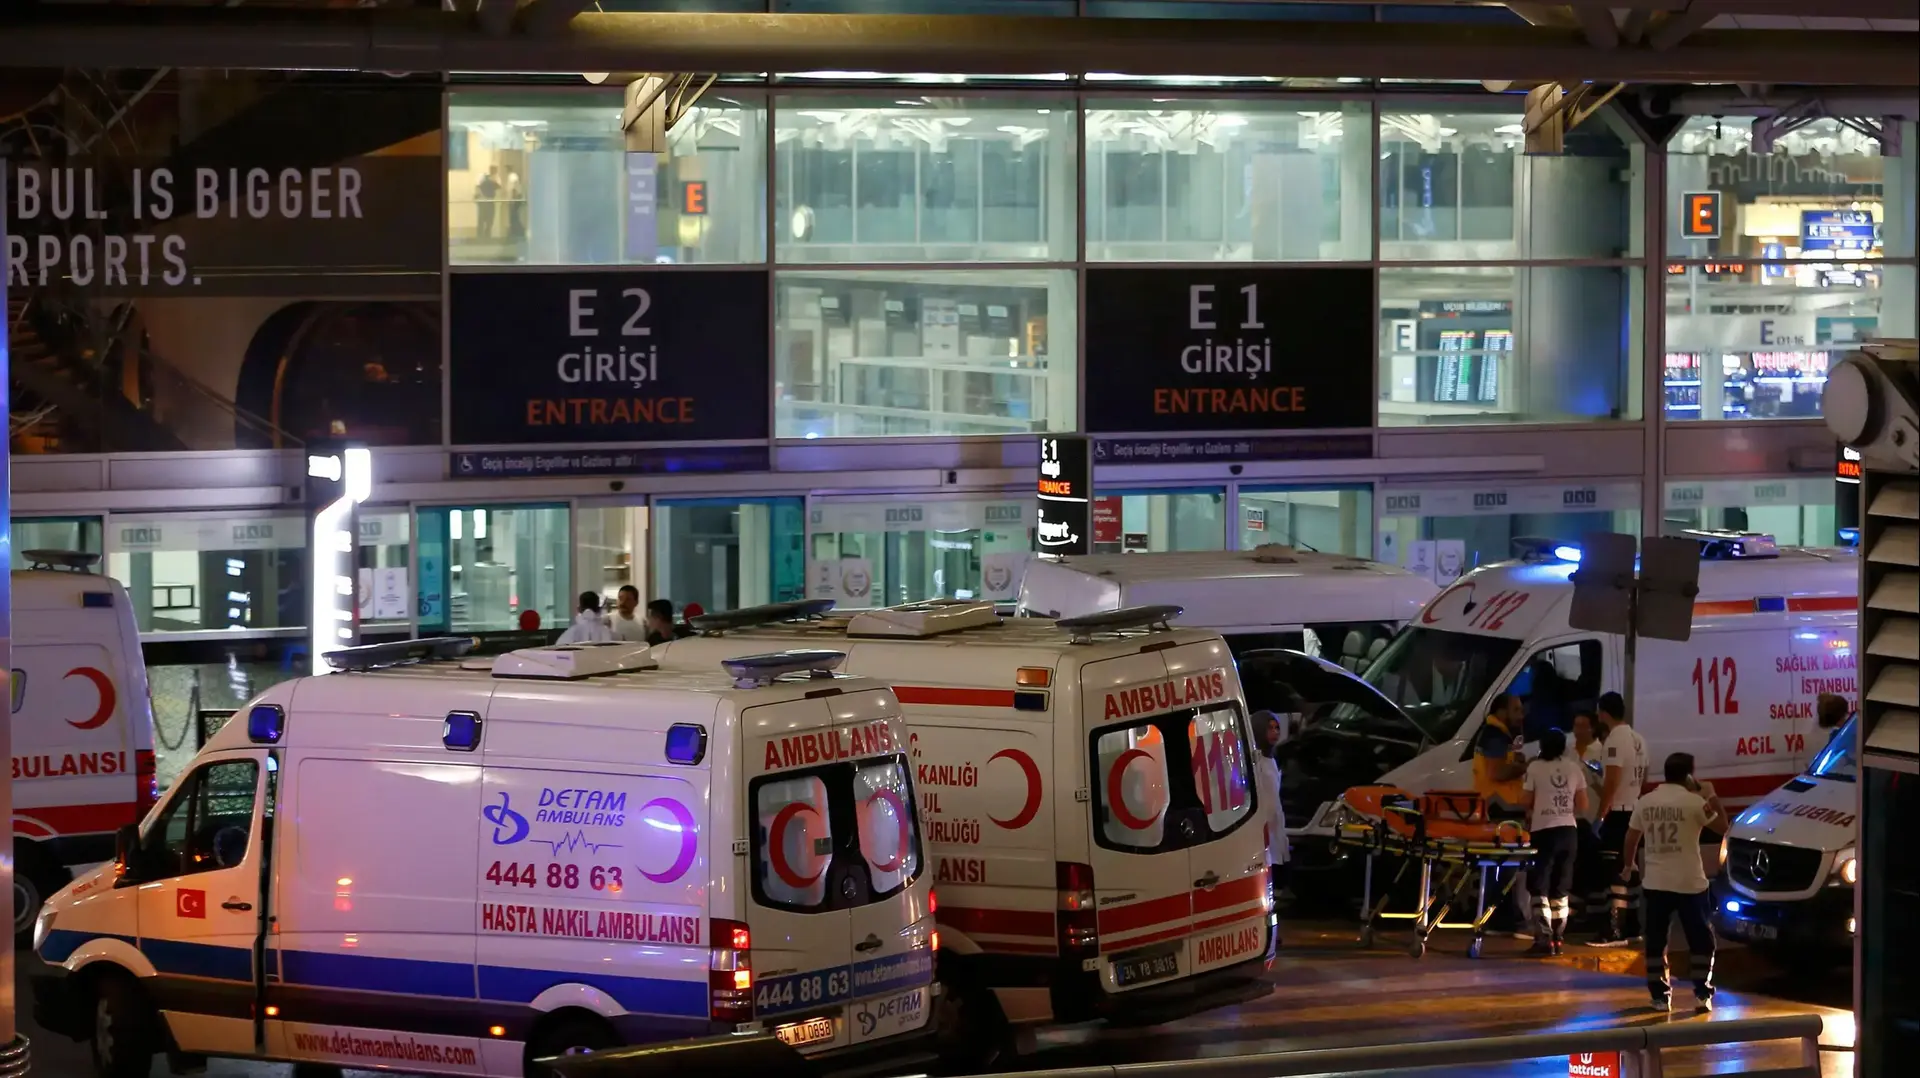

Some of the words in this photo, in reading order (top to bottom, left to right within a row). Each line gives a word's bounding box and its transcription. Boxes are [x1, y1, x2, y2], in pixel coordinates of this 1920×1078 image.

[18, 168, 107, 219] BUL
[134, 168, 174, 218] IS
[197, 167, 363, 218] BIGGER
[686, 184, 704, 212] E
[1691, 196, 1713, 233] E
[7, 235, 202, 286] RPORTS.
[569, 289, 598, 336] E
[621, 288, 650, 336] 2
[1190, 285, 1216, 329] E
[1240, 284, 1264, 328] 1
[1397, 324, 1411, 350] E
[1760, 320, 1774, 345] E
[557, 346, 657, 388] GİRİŞİ
[1181, 338, 1271, 379] GİRİŞİ
[527, 398, 694, 425] ENTRANCE
[1155, 387, 1305, 413] ENTRANCE
[1469, 590, 1530, 631] 112
[1776, 654, 1819, 673] SAĞLIK
[1104, 672, 1224, 720] AMBULANS
[1692, 656, 1738, 715] 112
[1769, 700, 1813, 720] SAĞLIK
[764, 723, 892, 771] AMBULANS
[1192, 729, 1245, 815] 112
[536, 809, 625, 827] AMBULANS
[538, 787, 627, 812] DETAM
[1648, 822, 1677, 844] 112
[486, 861, 537, 888] 444
[547, 863, 579, 889] 88
[590, 866, 623, 892] 63
[933, 858, 986, 883] ANSI
[483, 903, 538, 933] HASTA
[596, 912, 700, 944] AMBULANSI
[1198, 926, 1259, 965] AMBULANS
[757, 981, 794, 1009] 444
[800, 976, 822, 1002] 88
[828, 970, 849, 996] 63
[878, 991, 921, 1019] DETAM
[293, 1030, 477, 1065] www.detamambulans.com
